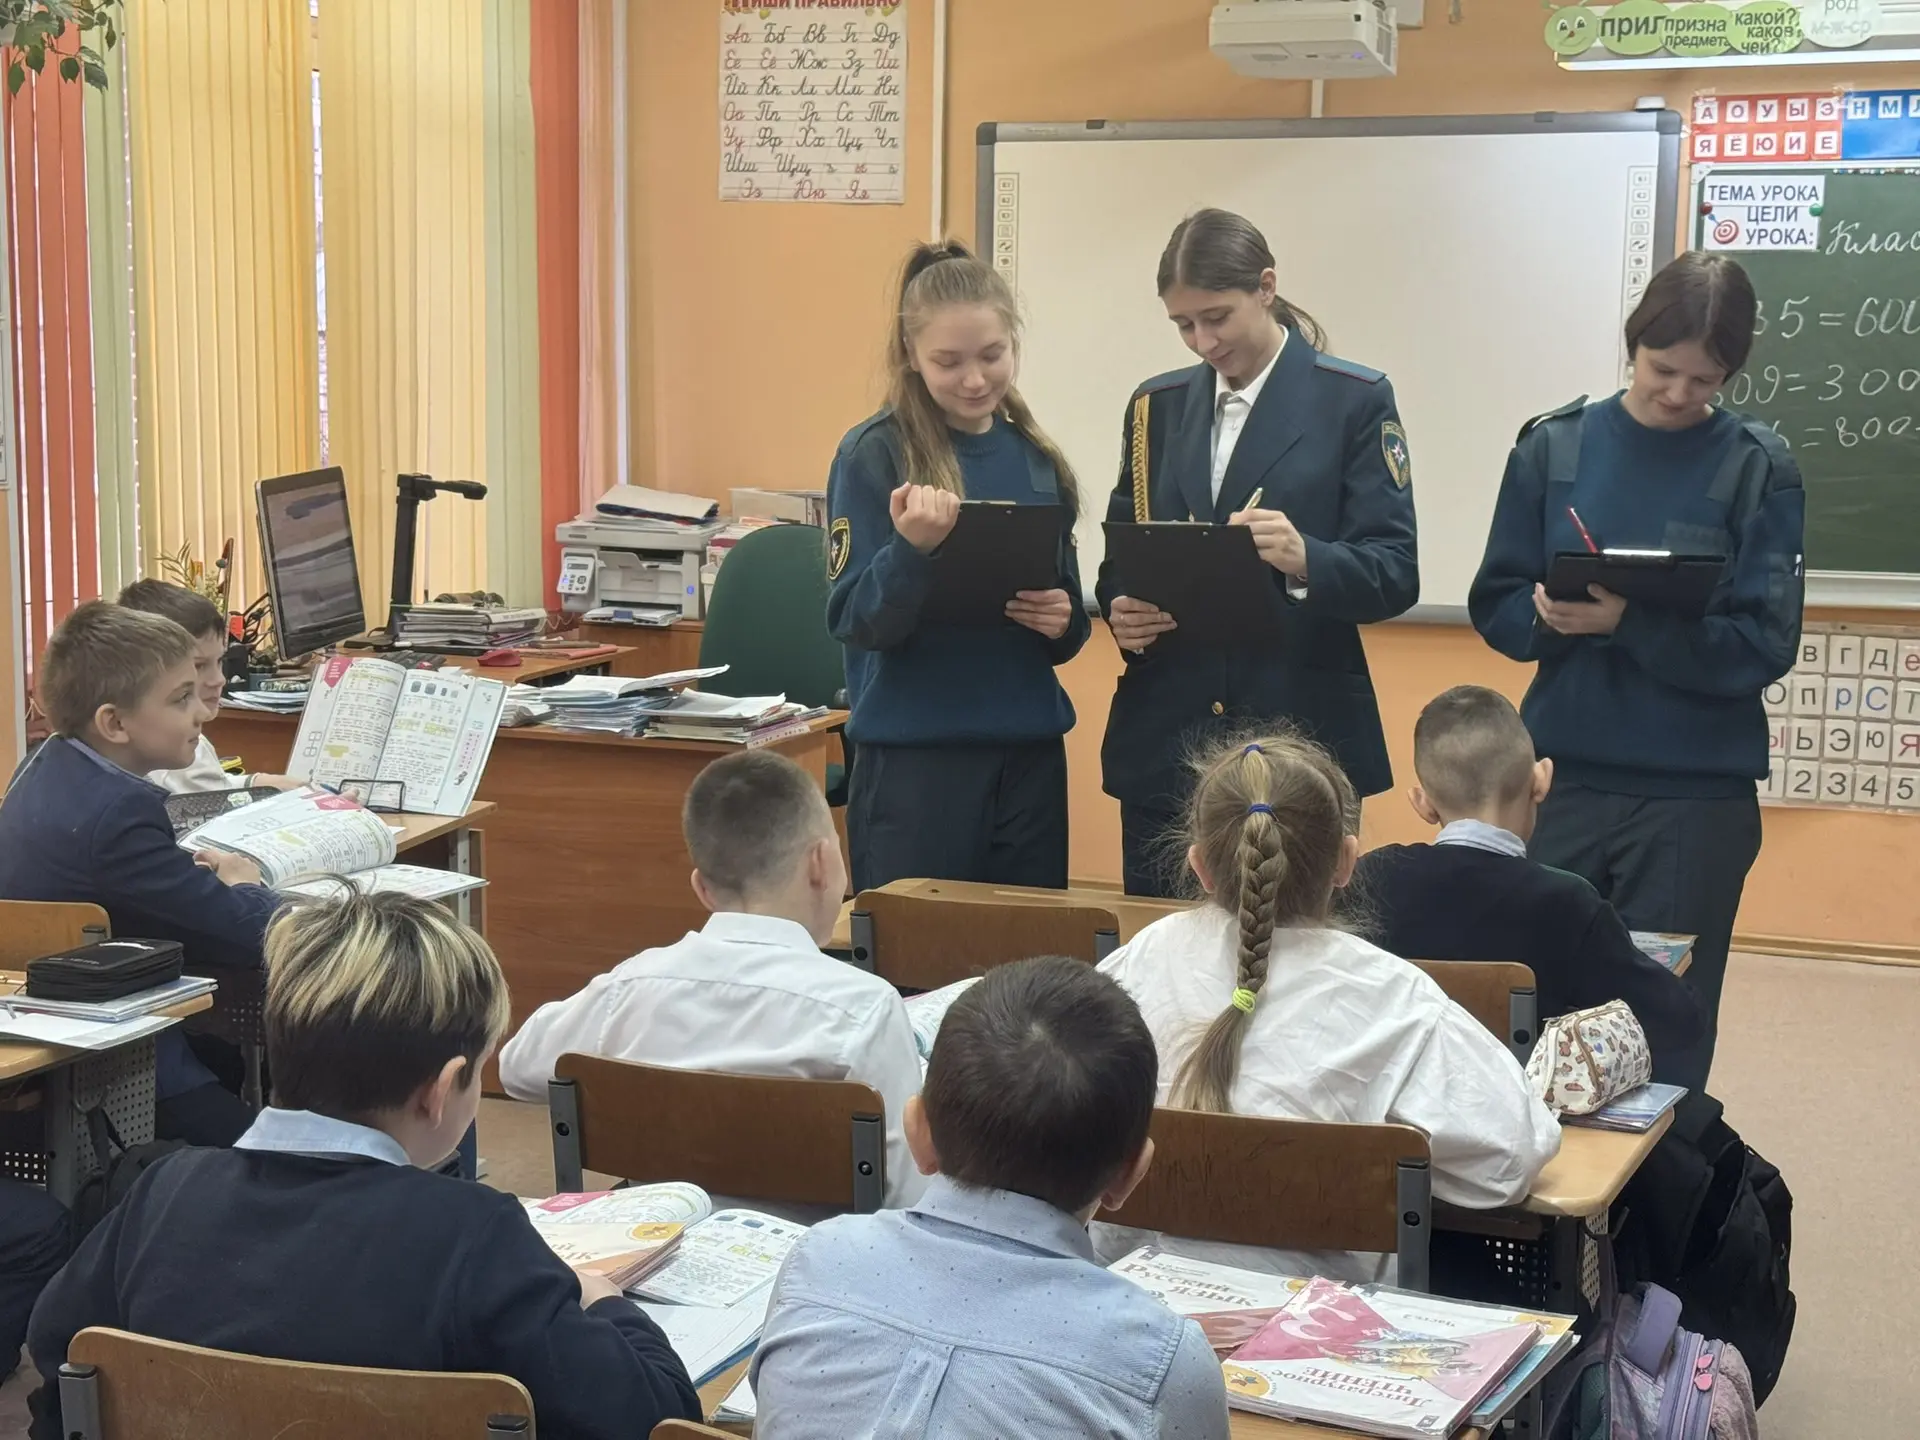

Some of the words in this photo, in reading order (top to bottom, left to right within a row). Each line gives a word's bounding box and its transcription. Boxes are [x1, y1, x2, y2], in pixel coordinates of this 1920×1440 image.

[1701, 107, 1713, 119] А
[1731, 105, 1745, 117] О
[1762, 104, 1774, 117] У
[1789, 103, 1805, 117] Ы
[1821, 102, 1834, 116] Э
[1854, 101, 1865, 114] Н
[1882, 101, 1898, 114] М
[1700, 140, 1711, 153] Я
[1731, 135, 1742, 152] Ё
[1756, 137, 1774, 151] Ю
[1789, 137, 1801, 150] И
[1822, 136, 1833, 149] Е
[1708, 185, 1756, 201] ТЕМА
[1760, 185, 1819, 201] УРОКА
[1747, 206, 1798, 225] ЦЕЛИ
[1745, 228, 1814, 245] УРОКА:
[1841, 647, 1852, 665] г
[1869, 648, 1888, 671] д
[1905, 654, 1920, 671] е
[1801, 687, 1816, 705] п
[1835, 687, 1852, 711] р
[1794, 770, 1812, 793] 2
[1827, 772, 1847, 795] 3
[1861, 775, 1878, 797] 4
[1897, 778, 1914, 800] 5
[1119, 1263, 1231, 1293] Русский
